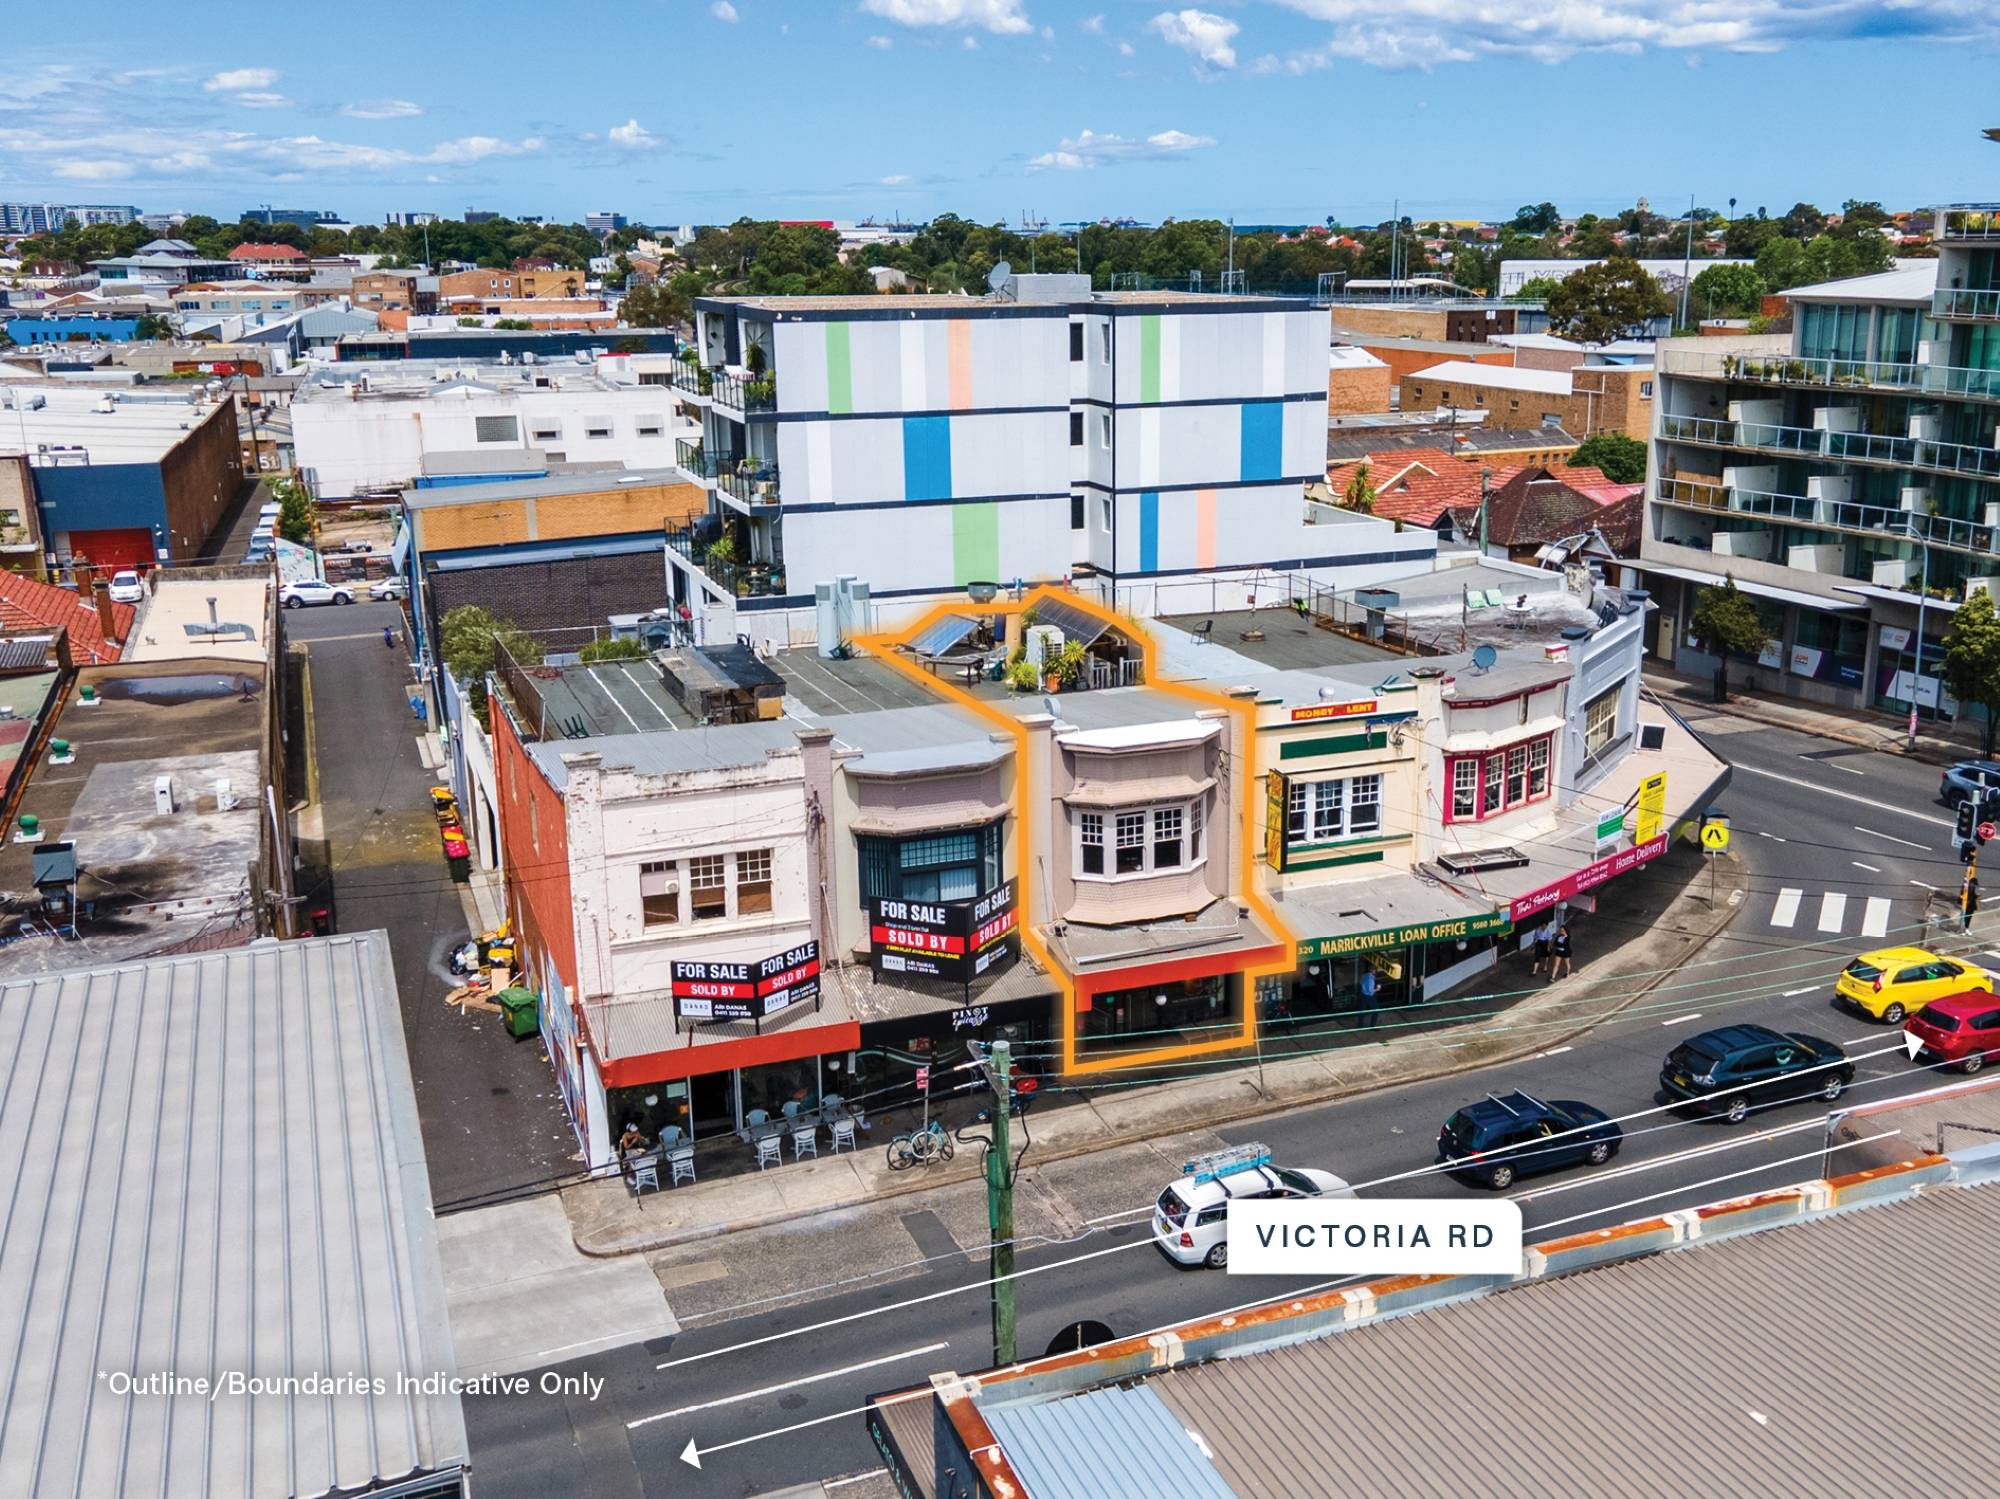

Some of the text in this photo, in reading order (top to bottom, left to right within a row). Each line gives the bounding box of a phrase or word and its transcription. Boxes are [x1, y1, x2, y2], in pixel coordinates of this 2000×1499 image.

[1295, 703, 1373, 719] MONEY LENT
[1616, 841, 1663, 870] Home Delivery
[880, 900, 946, 925] FOR SALE
[975, 900, 990, 921] FOR
[991, 886, 1011, 909] SALE
[1516, 898, 1532, 914] Thai
[980, 920, 1000, 944] SOLD
[1002, 911, 1012, 930] BY
[1320, 932, 1395, 955] MARRICKVILLE
[1399, 927, 1427, 943] LOAN
[1432, 921, 1467, 938] OFFICE
[888, 930, 948, 950] SOLD BY
[677, 963, 748, 980] FOR SALE
[761, 943, 815, 977] FOR SALE
[772, 967, 807, 989] SOLD BY
[690, 985, 735, 997] SOLD BY
